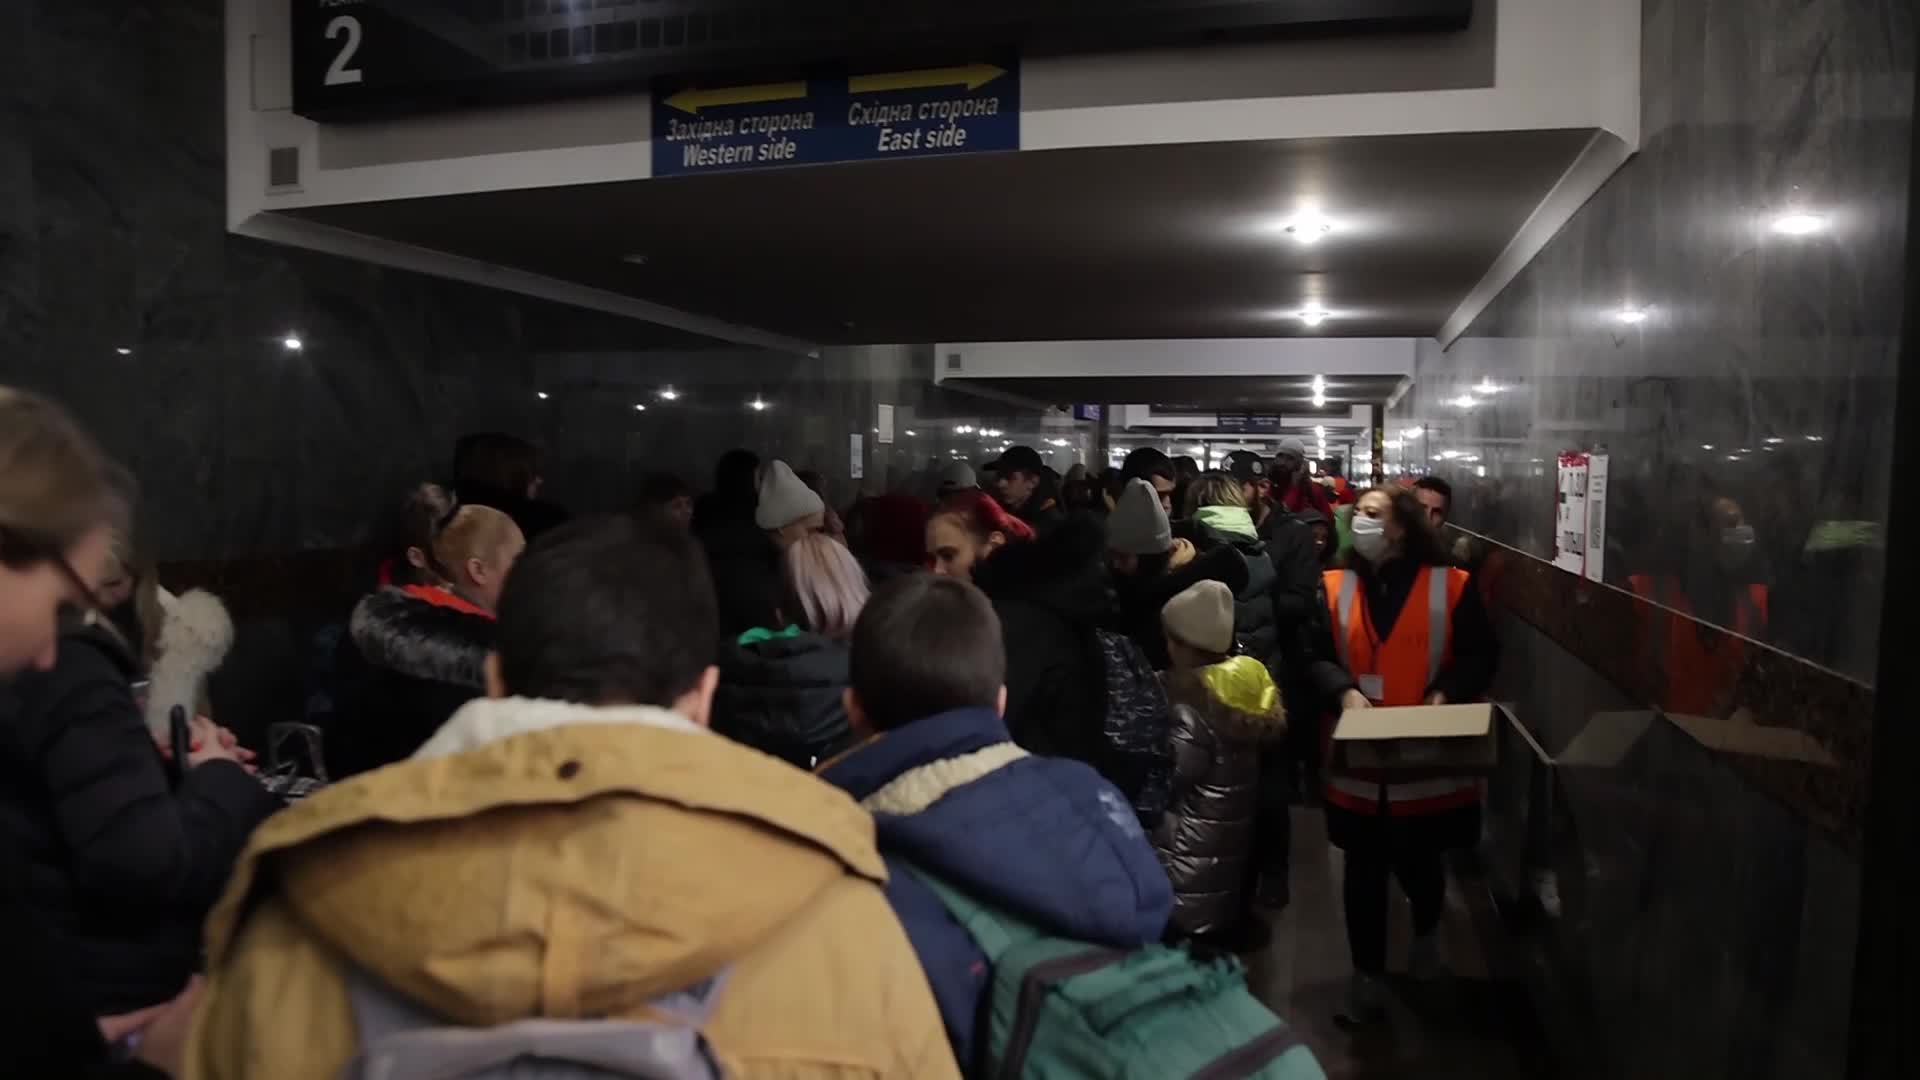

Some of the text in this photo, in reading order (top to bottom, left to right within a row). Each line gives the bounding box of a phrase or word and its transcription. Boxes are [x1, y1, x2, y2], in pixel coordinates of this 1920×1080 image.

[324, 15, 362, 86] 2
[665, 111, 815, 142] Західна сторона
[848, 96, 999, 127] Східна сторона
[683, 137, 797, 167] Western side
[878, 123, 966, 151] East side
